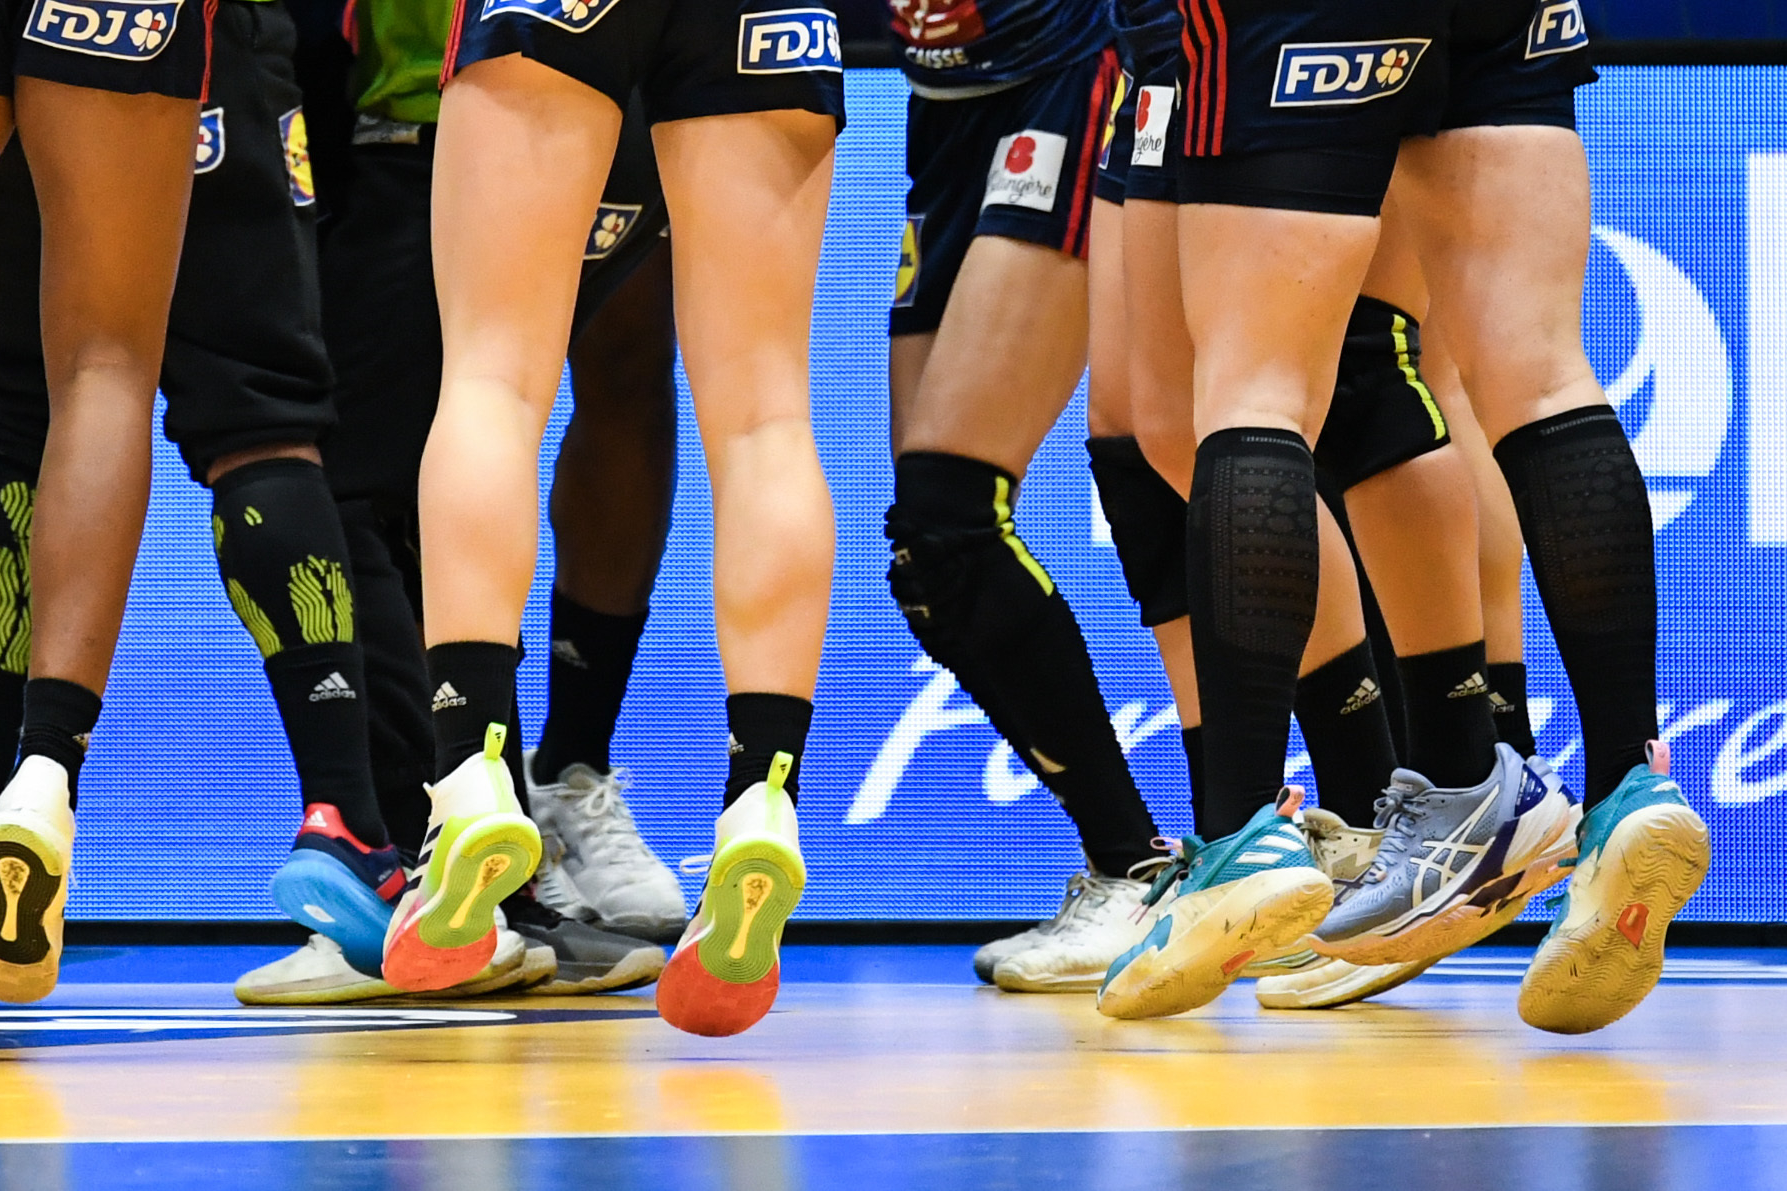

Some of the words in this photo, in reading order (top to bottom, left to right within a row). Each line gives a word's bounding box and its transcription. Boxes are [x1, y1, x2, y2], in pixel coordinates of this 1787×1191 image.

[36, 0, 127, 45] FDJ
[749, 20, 824, 63] FDJ
[1285, 53, 1374, 94] FDJ
[309, 688, 356, 702] adidas
